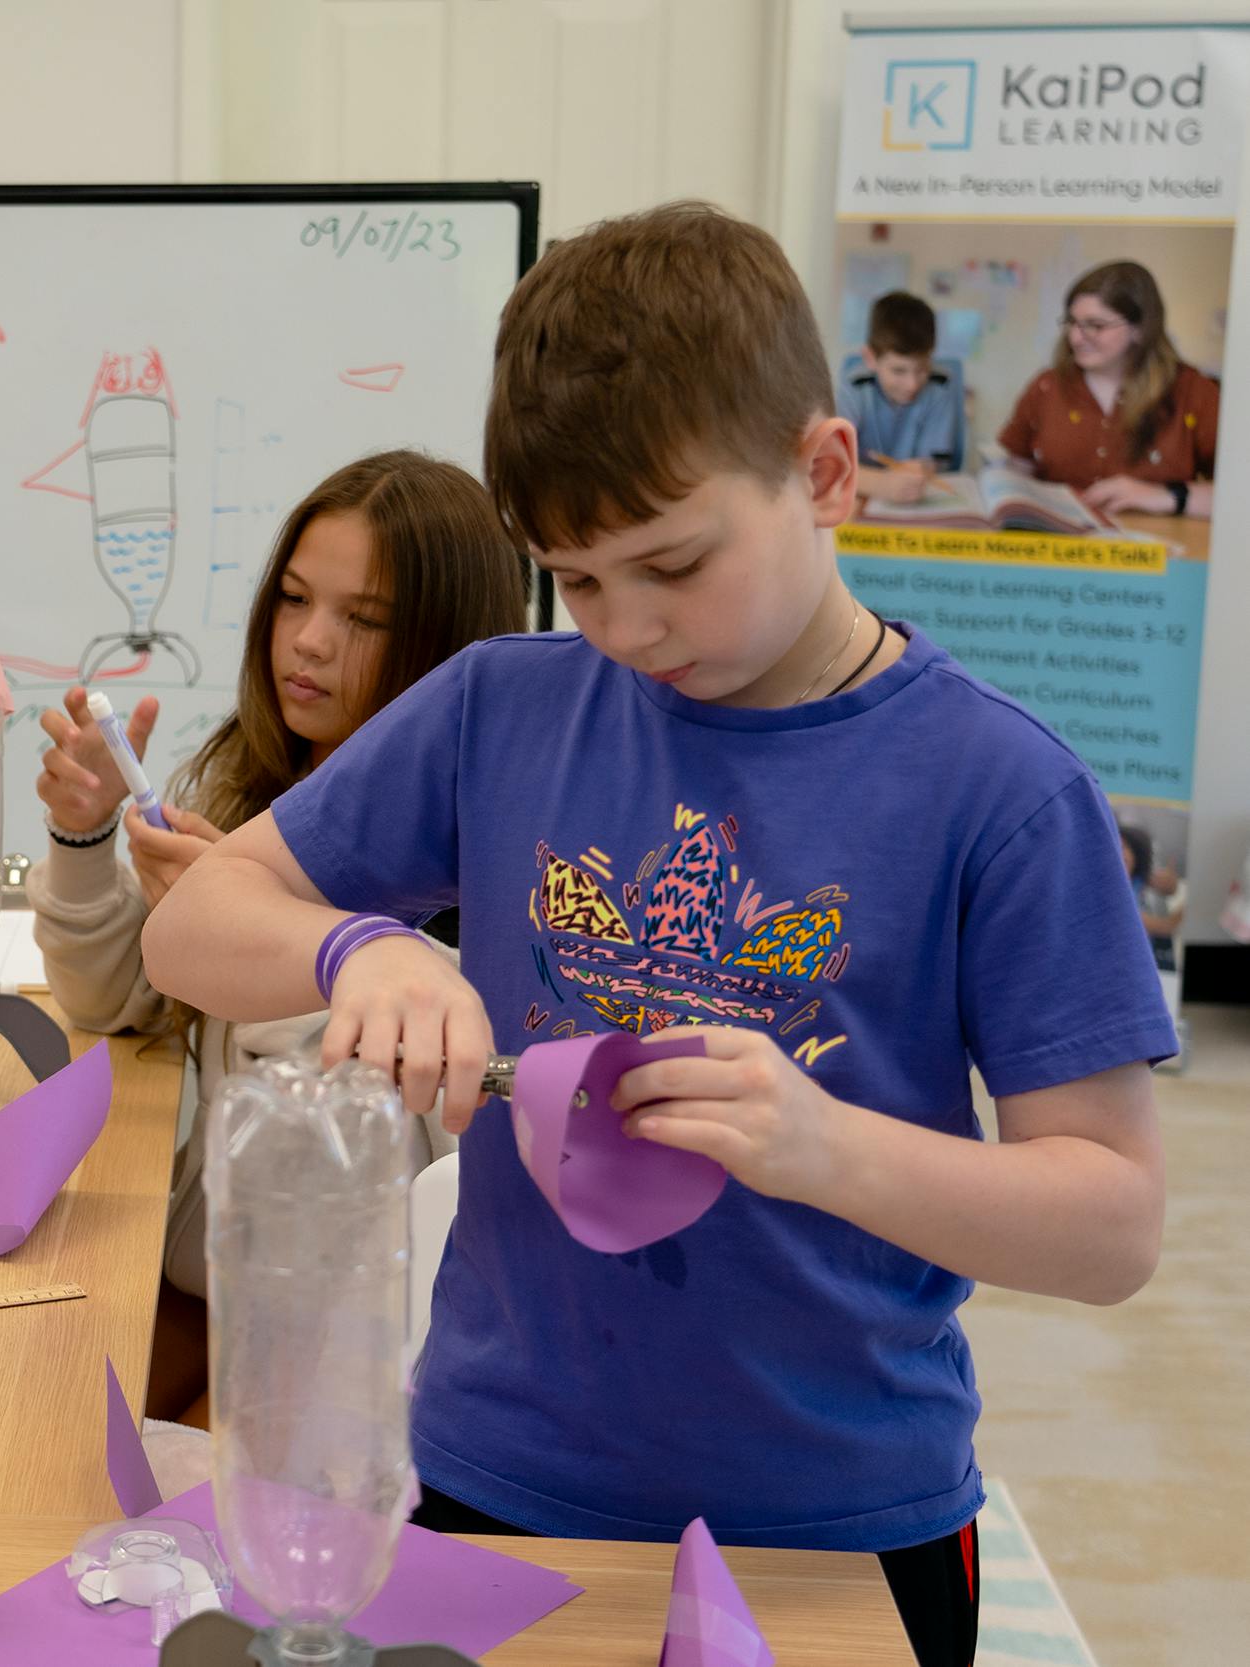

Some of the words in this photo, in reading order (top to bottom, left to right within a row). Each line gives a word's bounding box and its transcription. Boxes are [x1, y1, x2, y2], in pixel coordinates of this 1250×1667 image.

[1000, 62, 1208, 109] KaiPod
[907, 80, 948, 130] K
[997, 117, 1203, 147] LEARNING
[852, 176, 869, 194] A
[874, 176, 920, 197] New
[927, 174, 1035, 198] In-Person
[1039, 175, 1143, 201] Learning
[1148, 175, 1223, 199] Model
[300, 209, 463, 263] 09/07/23
[836, 530, 890, 548] Want
[896, 533, 917, 550] To
[923, 535, 980, 554] Learn
[984, 539, 1048, 558] More?
[1053, 543, 1104, 563] Let's
[1110, 545, 1160, 567] Talk!
[851, 568, 906, 590] Small
[910, 571, 976, 597] Group
[979, 576, 1073, 607] Learning
[1078, 582, 1166, 609] Centers
[934, 605, 1017, 635] Support
[1021, 611, 1052, 636] for
[1056, 615, 1136, 642] Grades
[1142, 620, 1188, 648] 3-12
[1043, 649, 1141, 678] Activities
[1034, 680, 1155, 711] Curriculum
[1064, 717, 1161, 748] Coaches
[1123, 757, 1181, 783] Plans
